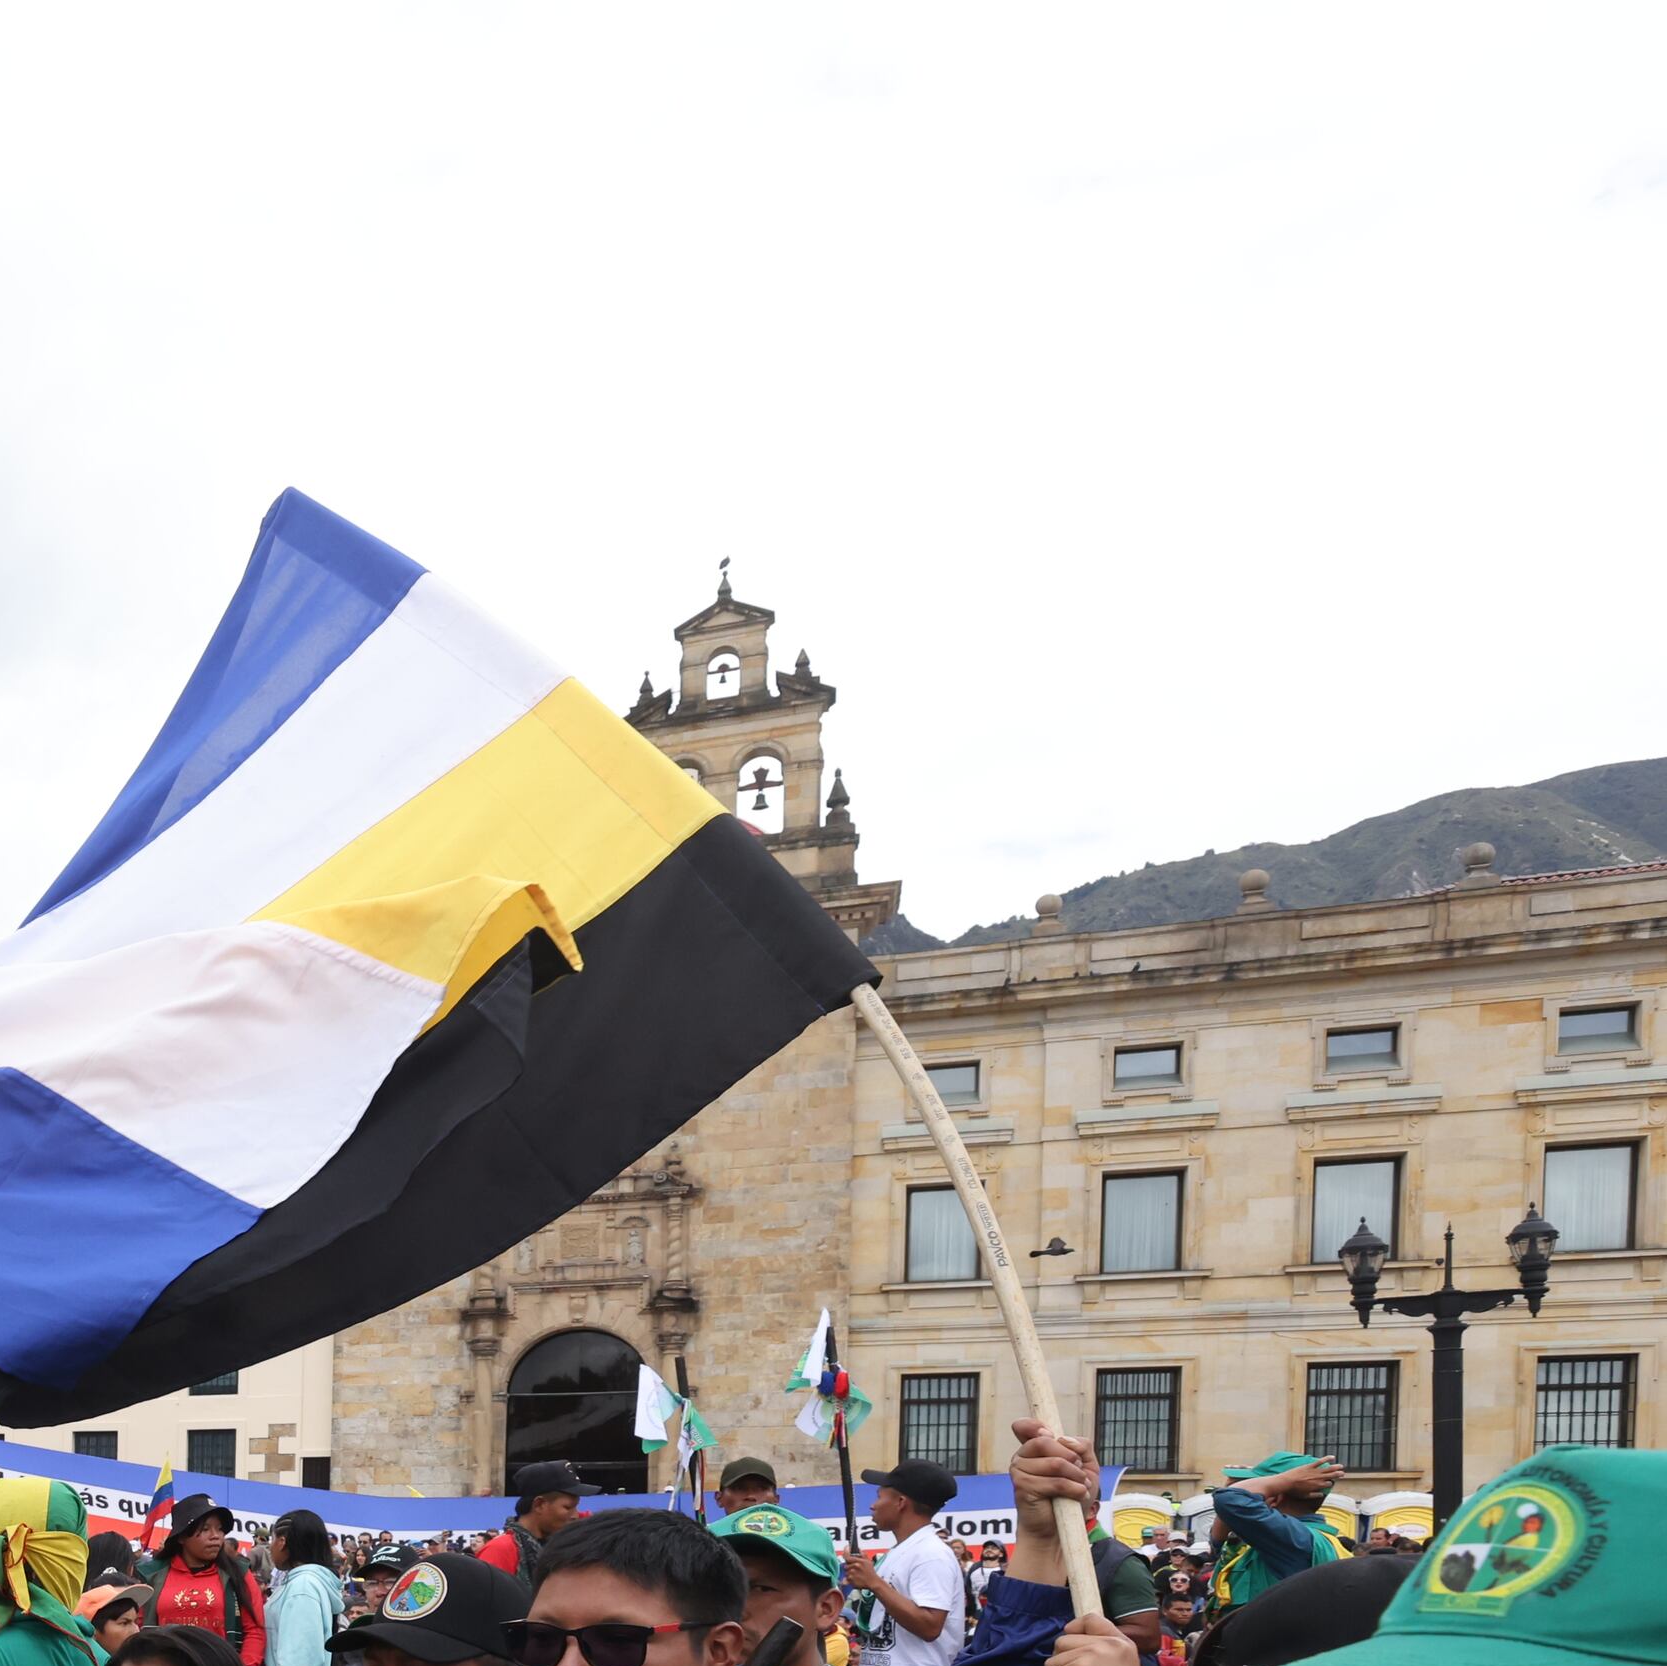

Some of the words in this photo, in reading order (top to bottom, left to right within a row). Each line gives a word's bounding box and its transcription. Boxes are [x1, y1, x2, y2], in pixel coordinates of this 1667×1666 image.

[78, 1487, 109, 1509] ás
[118, 1499, 148, 1519] qu
[825, 1521, 880, 1542] ara
